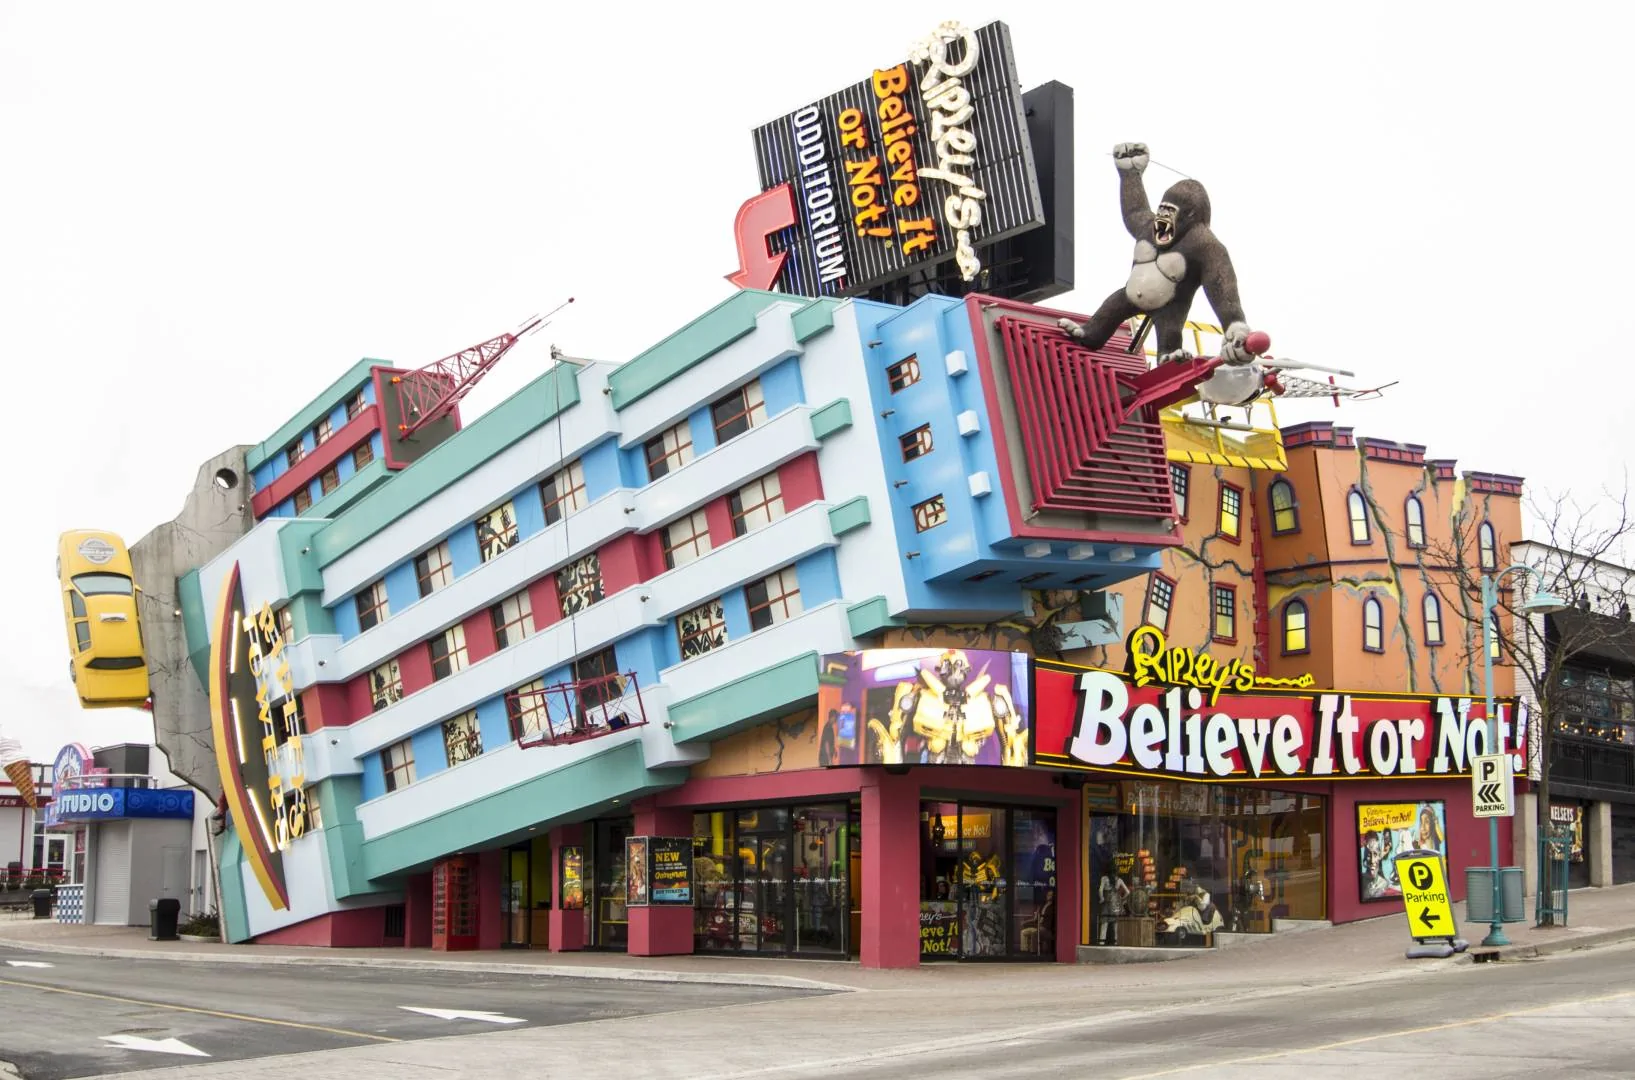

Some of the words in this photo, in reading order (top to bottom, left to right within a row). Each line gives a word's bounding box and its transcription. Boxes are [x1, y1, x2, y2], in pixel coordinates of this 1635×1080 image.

[838, 108, 869, 150] or
[872, 64, 921, 209] Believe
[898, 215, 937, 256] It
[793, 105, 847, 284] ODDITORIUM
[845, 155, 893, 239] Not!
[1070, 670, 1304, 778] Believe
[1312, 694, 1361, 775] It
[1369, 718, 1424, 776] or
[1433, 695, 1528, 774] Not!
[1483, 762, 1494, 780] P
[60, 793, 114, 813] STUDIO
[1476, 803, 1505, 812] PARKING
[1551, 805, 1574, 821] KELSEYS
[655, 851, 680, 862] NEW
[1412, 865, 1429, 887] P
[1406, 892, 1445, 903] Parking
[922, 937, 951, 953] Not!
